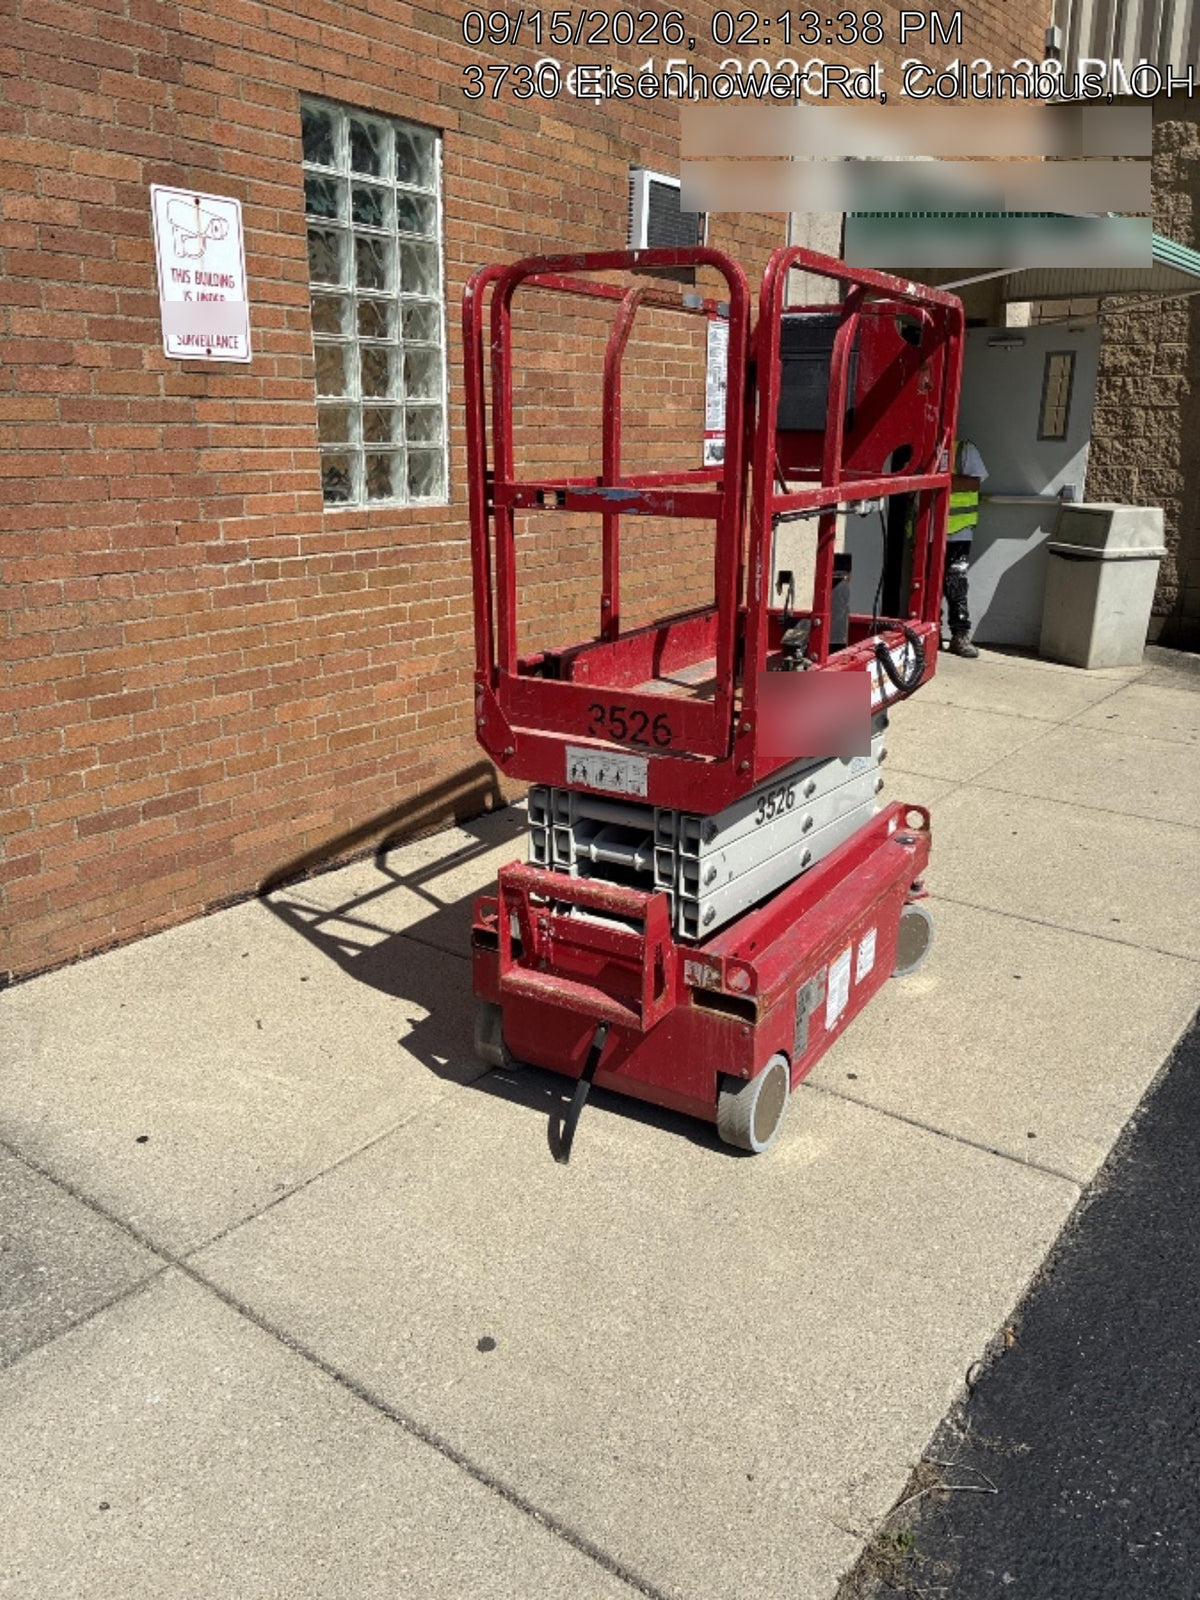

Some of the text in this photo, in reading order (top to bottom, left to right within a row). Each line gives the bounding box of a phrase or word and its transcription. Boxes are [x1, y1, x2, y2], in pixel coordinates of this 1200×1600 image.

[171, 267, 236, 289] THIS BUILDING
[587, 703, 673, 748] 3526
[755, 782, 796, 826] 3526
